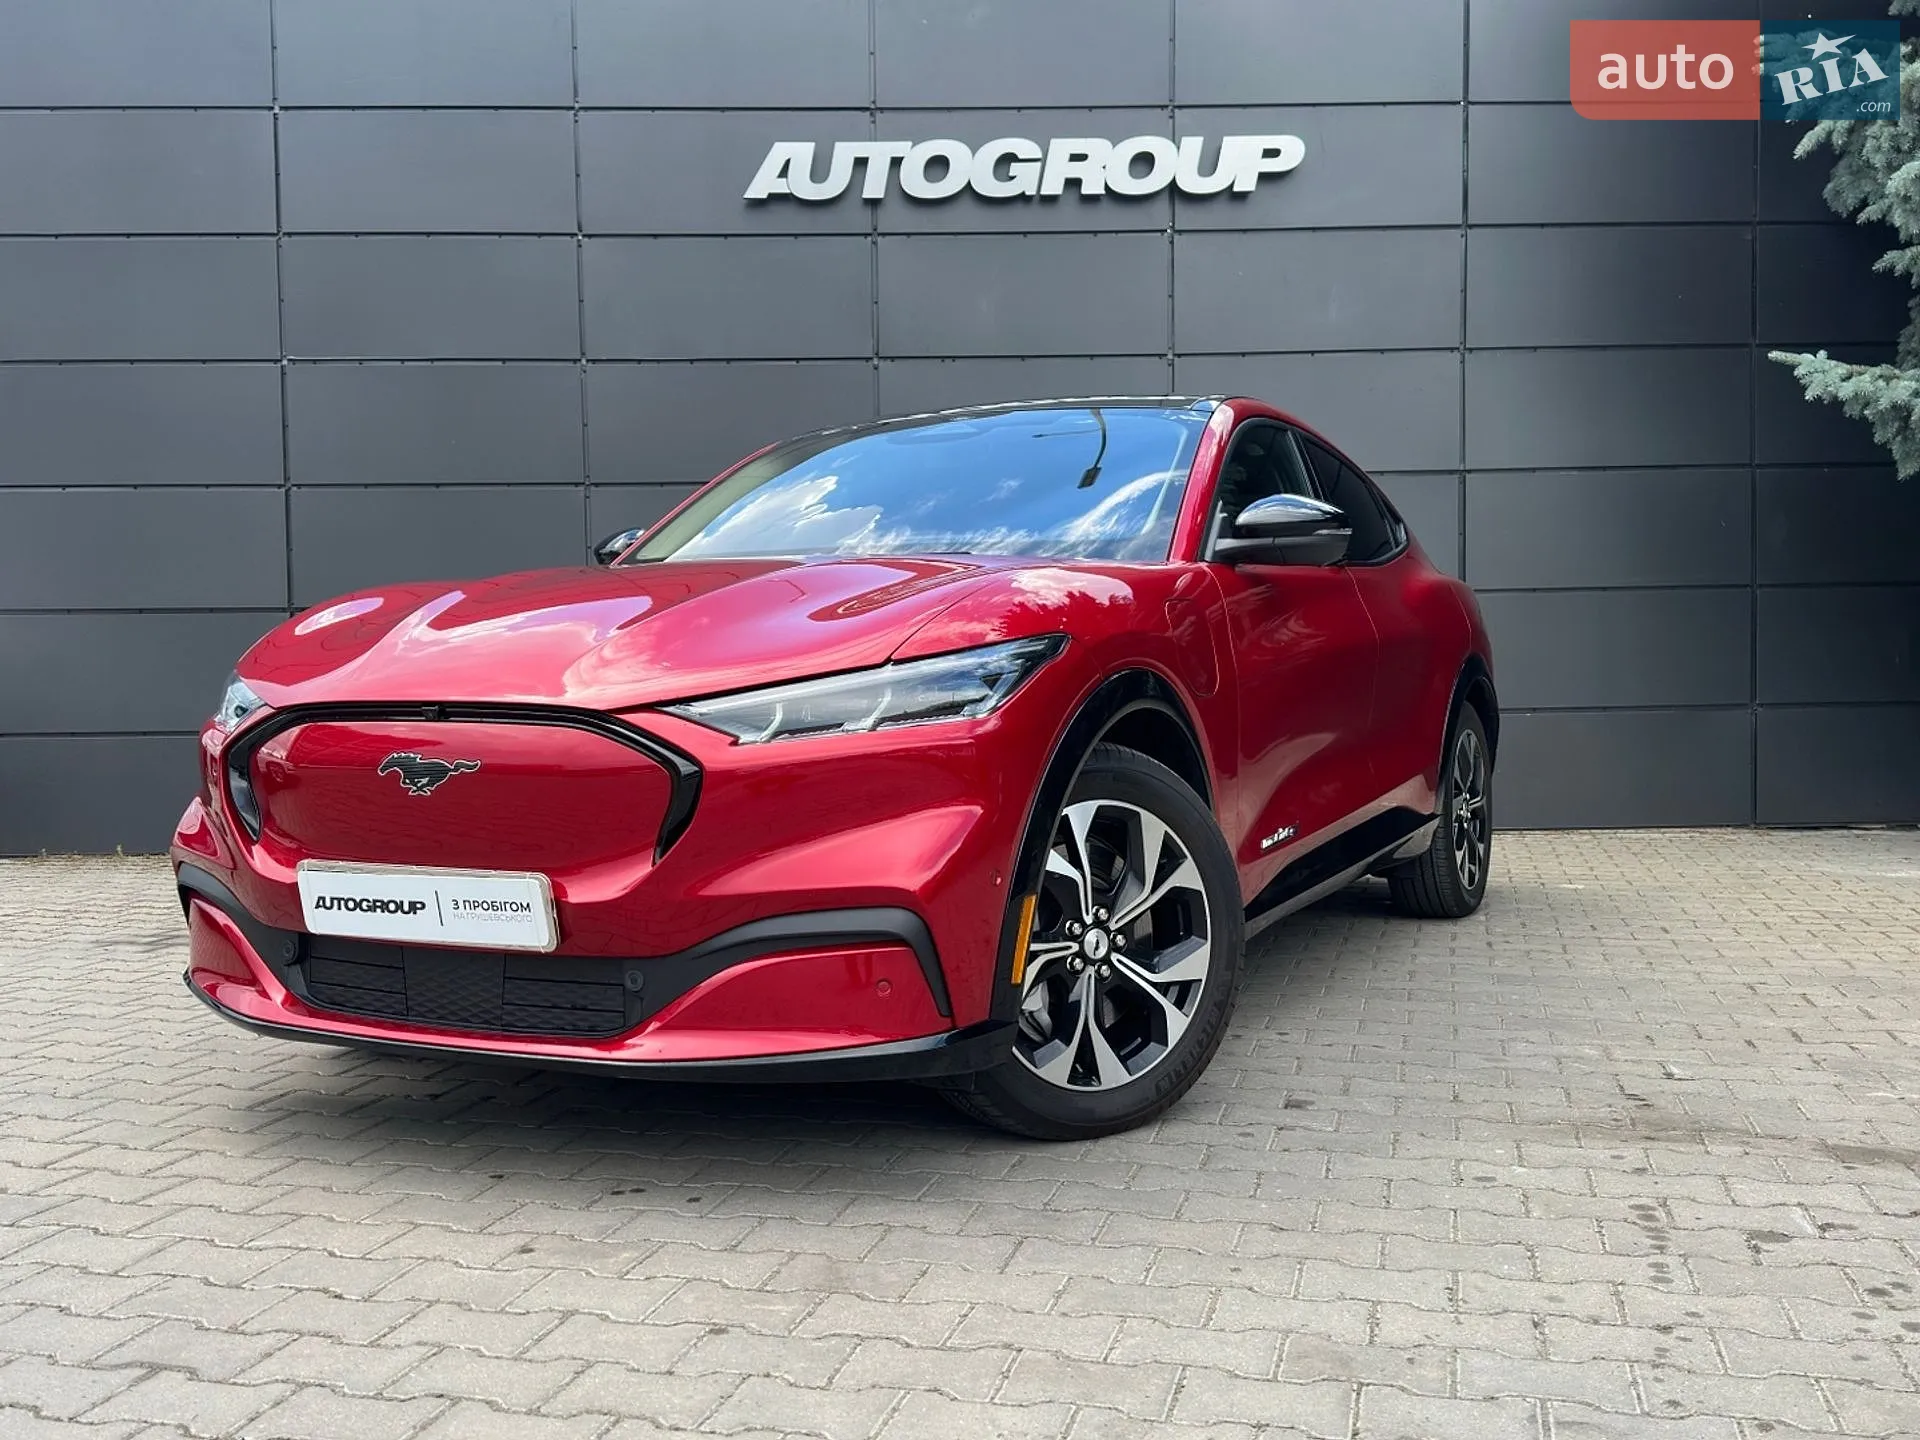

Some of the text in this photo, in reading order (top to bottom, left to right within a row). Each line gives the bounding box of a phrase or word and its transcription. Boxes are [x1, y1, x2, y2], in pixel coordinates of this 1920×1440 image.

[742, 134, 1306, 200] AUTOGROUP
[315, 896, 426, 915] AUTOGROUP
[462, 899, 532, 913] ПРОБІГОМ
